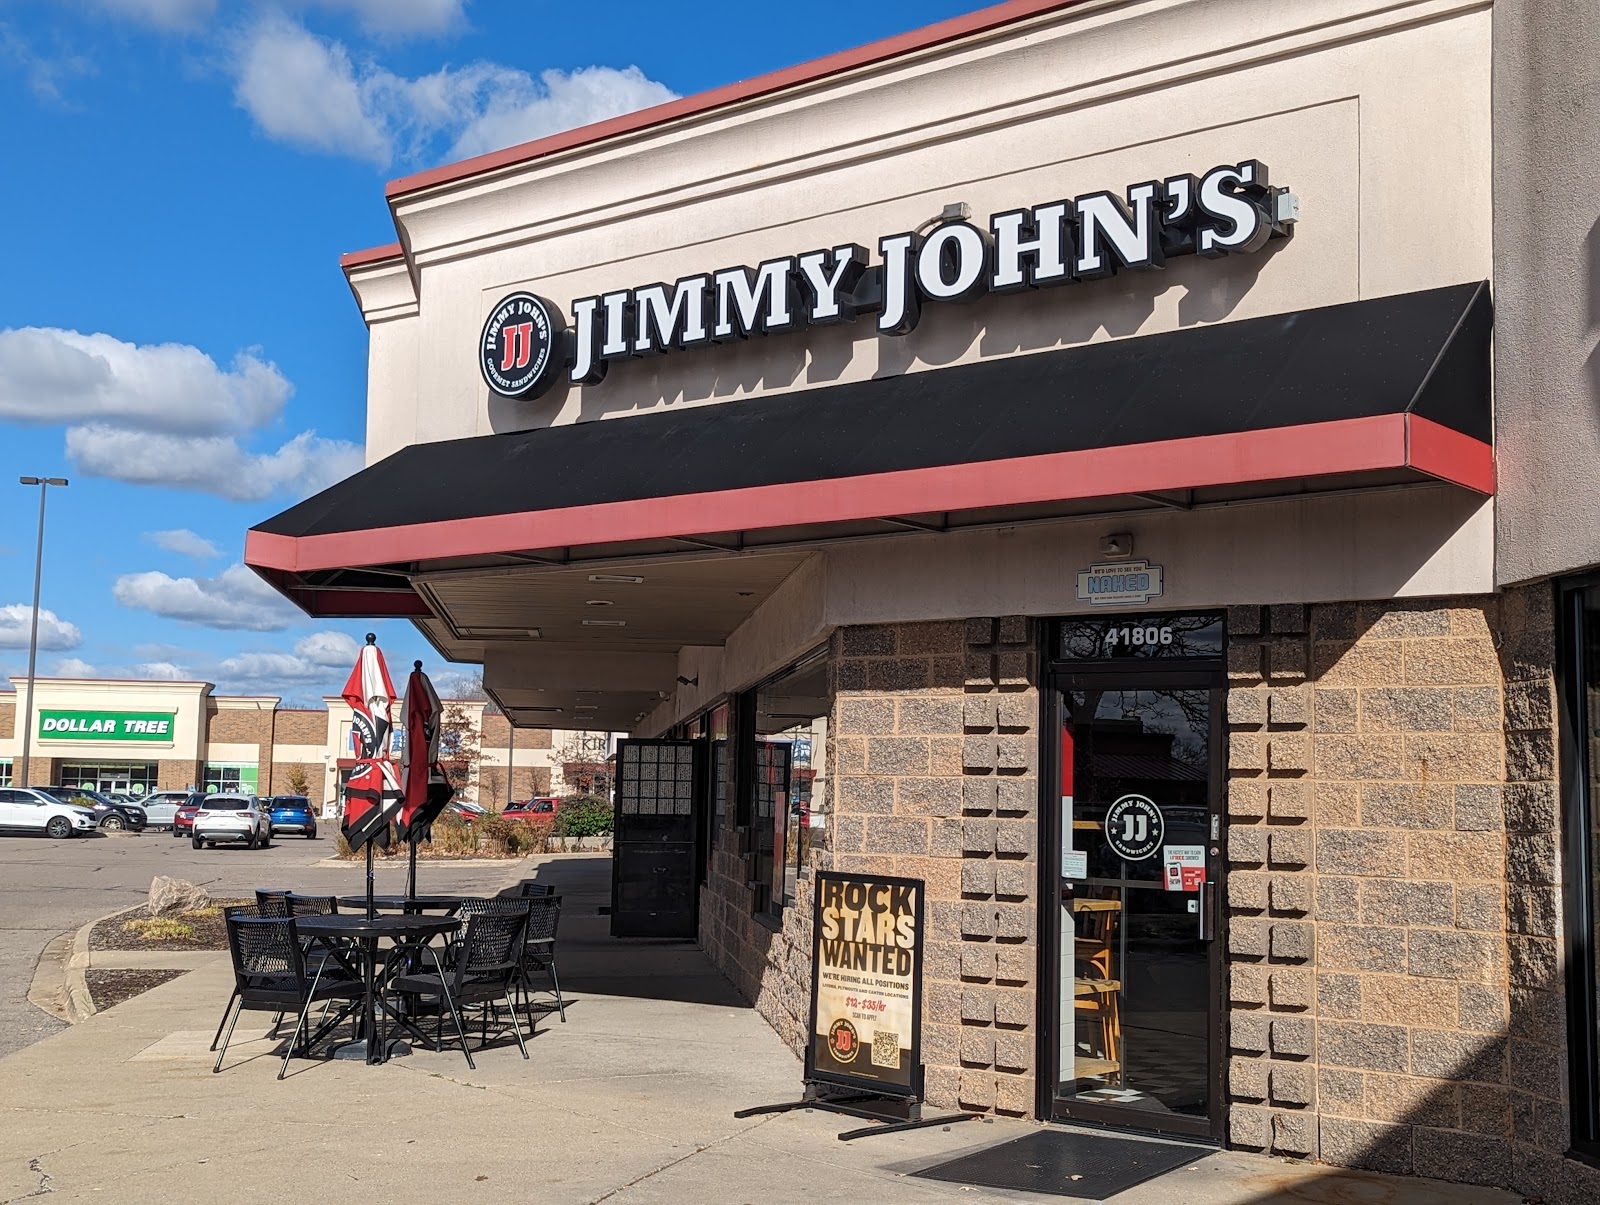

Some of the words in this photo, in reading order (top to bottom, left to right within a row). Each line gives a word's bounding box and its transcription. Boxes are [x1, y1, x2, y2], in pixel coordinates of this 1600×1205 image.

[571, 247, 853, 381] JIMMY
[879, 163, 1253, 330] JOHN'S
[486, 303, 515, 350] JIMMY
[518, 301, 547, 340] JOHN'S
[501, 322, 533, 371] JJ
[487, 358, 510, 388] GOURMET
[511, 348, 546, 388] SANDWICHES
[1088, 573, 1149, 594] NAKED
[1105, 626, 1173, 646] 41806
[42, 718, 116, 732] DOLLAR
[124, 720, 169, 734] TREE
[352, 716, 372, 744] JOHN'S
[1111, 800, 1134, 823] JIMMY
[1135, 800, 1158, 824] JOHN'S
[1122, 815, 1147, 841] JJ
[1115, 840, 1154, 854] SANDWICHES
[824, 880, 914, 916] ROCK
[822, 907, 915, 948] STARS
[823, 939, 911, 976] WANTED
[823, 972, 840, 981] WE'RE
[841, 974, 860, 984] HIRING
[862, 977, 874, 986] ALL
[875, 979, 909, 990] POSITIONS
[836, 1030, 851, 1051] JJ
